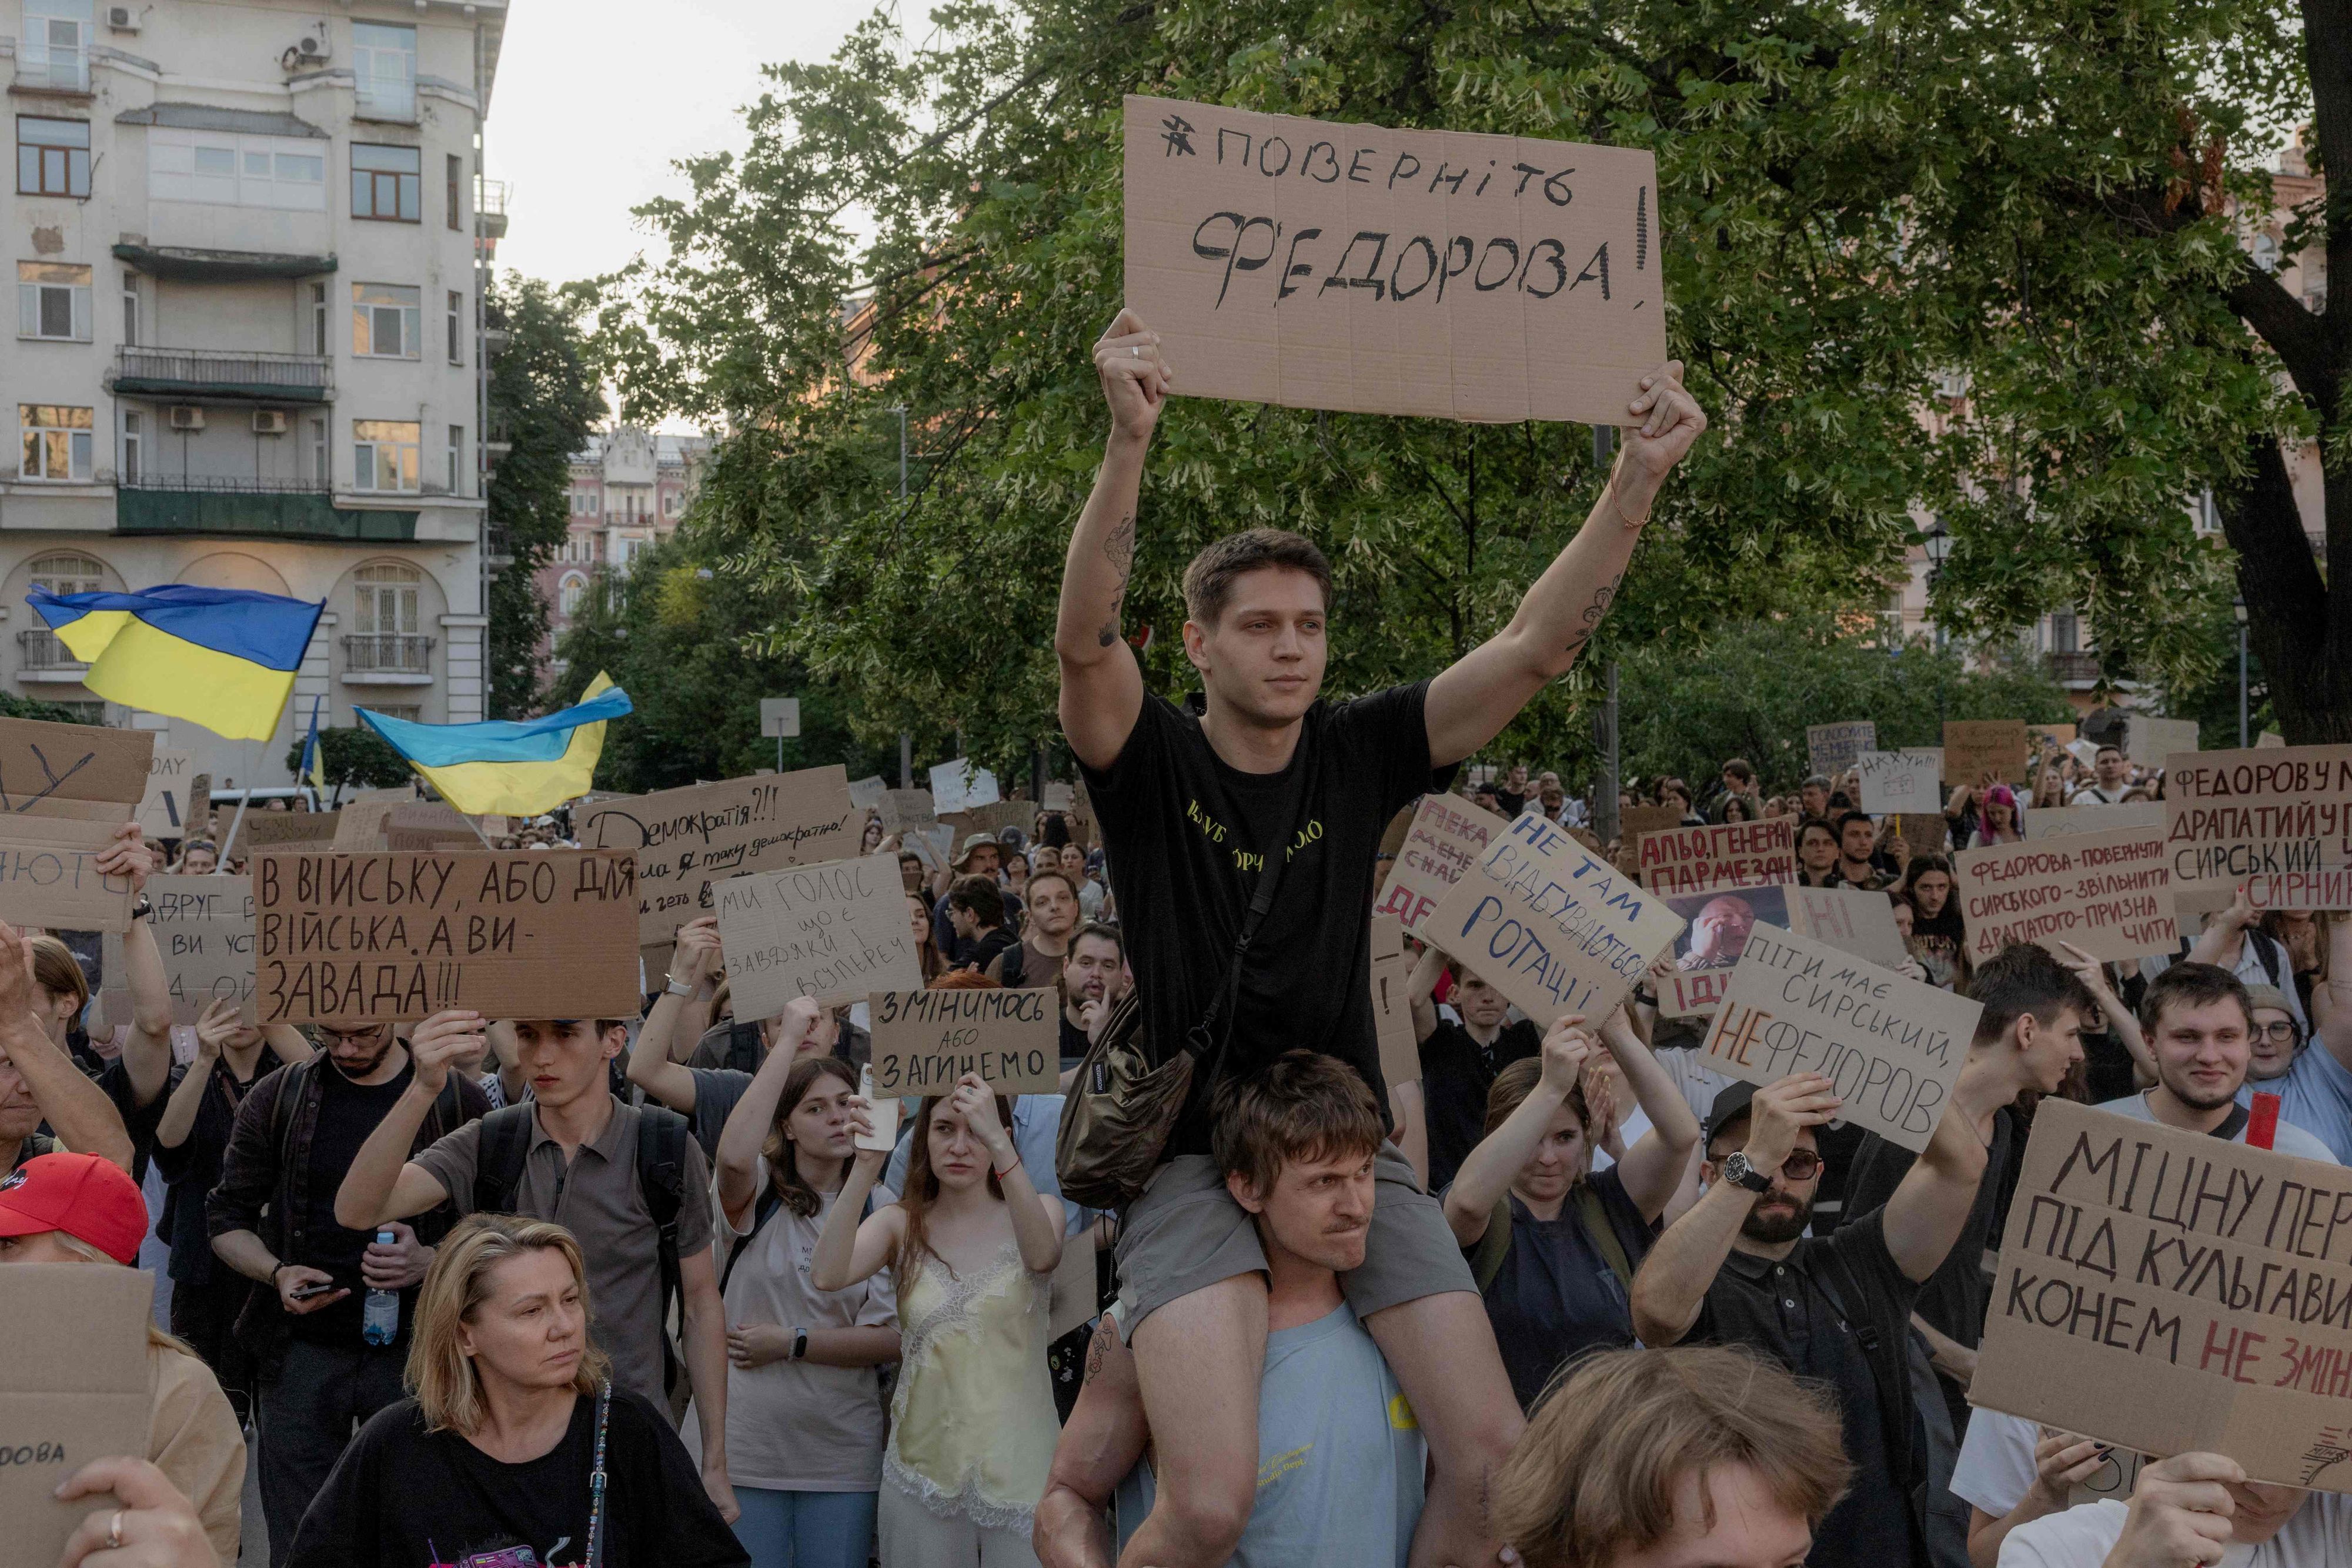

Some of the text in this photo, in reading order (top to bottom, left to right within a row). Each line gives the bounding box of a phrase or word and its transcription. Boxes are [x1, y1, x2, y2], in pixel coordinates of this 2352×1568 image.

[262, 857, 280, 908] В
[479, 860, 556, 904] АБО
[574, 857, 636, 902] ДЛЯ
[723, 885, 762, 920] МИ
[775, 866, 874, 911] ГОЛОС
[1511, 815, 1642, 922] НЕ ТАМ
[1651, 855, 1795, 896] ПАРМЕЗАН
[172, 934, 203, 956] ВИ
[427, 915, 453, 957] А
[727, 934, 838, 978] ЗАВДЯКИ
[2122, 917, 2176, 945] ЧИТИ
[266, 959, 462, 1022] ЗАВАДА!!!
[796, 937, 907, 997] ВСУПЕРЕЧ
[1743, 936, 1892, 998] ПІТИ МАЄ
[937, 1028, 979, 1054] АБО
[881, 1049, 1045, 1088] ЗАГИНЕМО
[2049, 1131, 2352, 1265] МІЦНУ ПЕР
[2023, 1194, 2117, 1283] ПІД
[2006, 1268, 2181, 1366] КОНЕМ
[2200, 1320, 2267, 1385] НЕ
